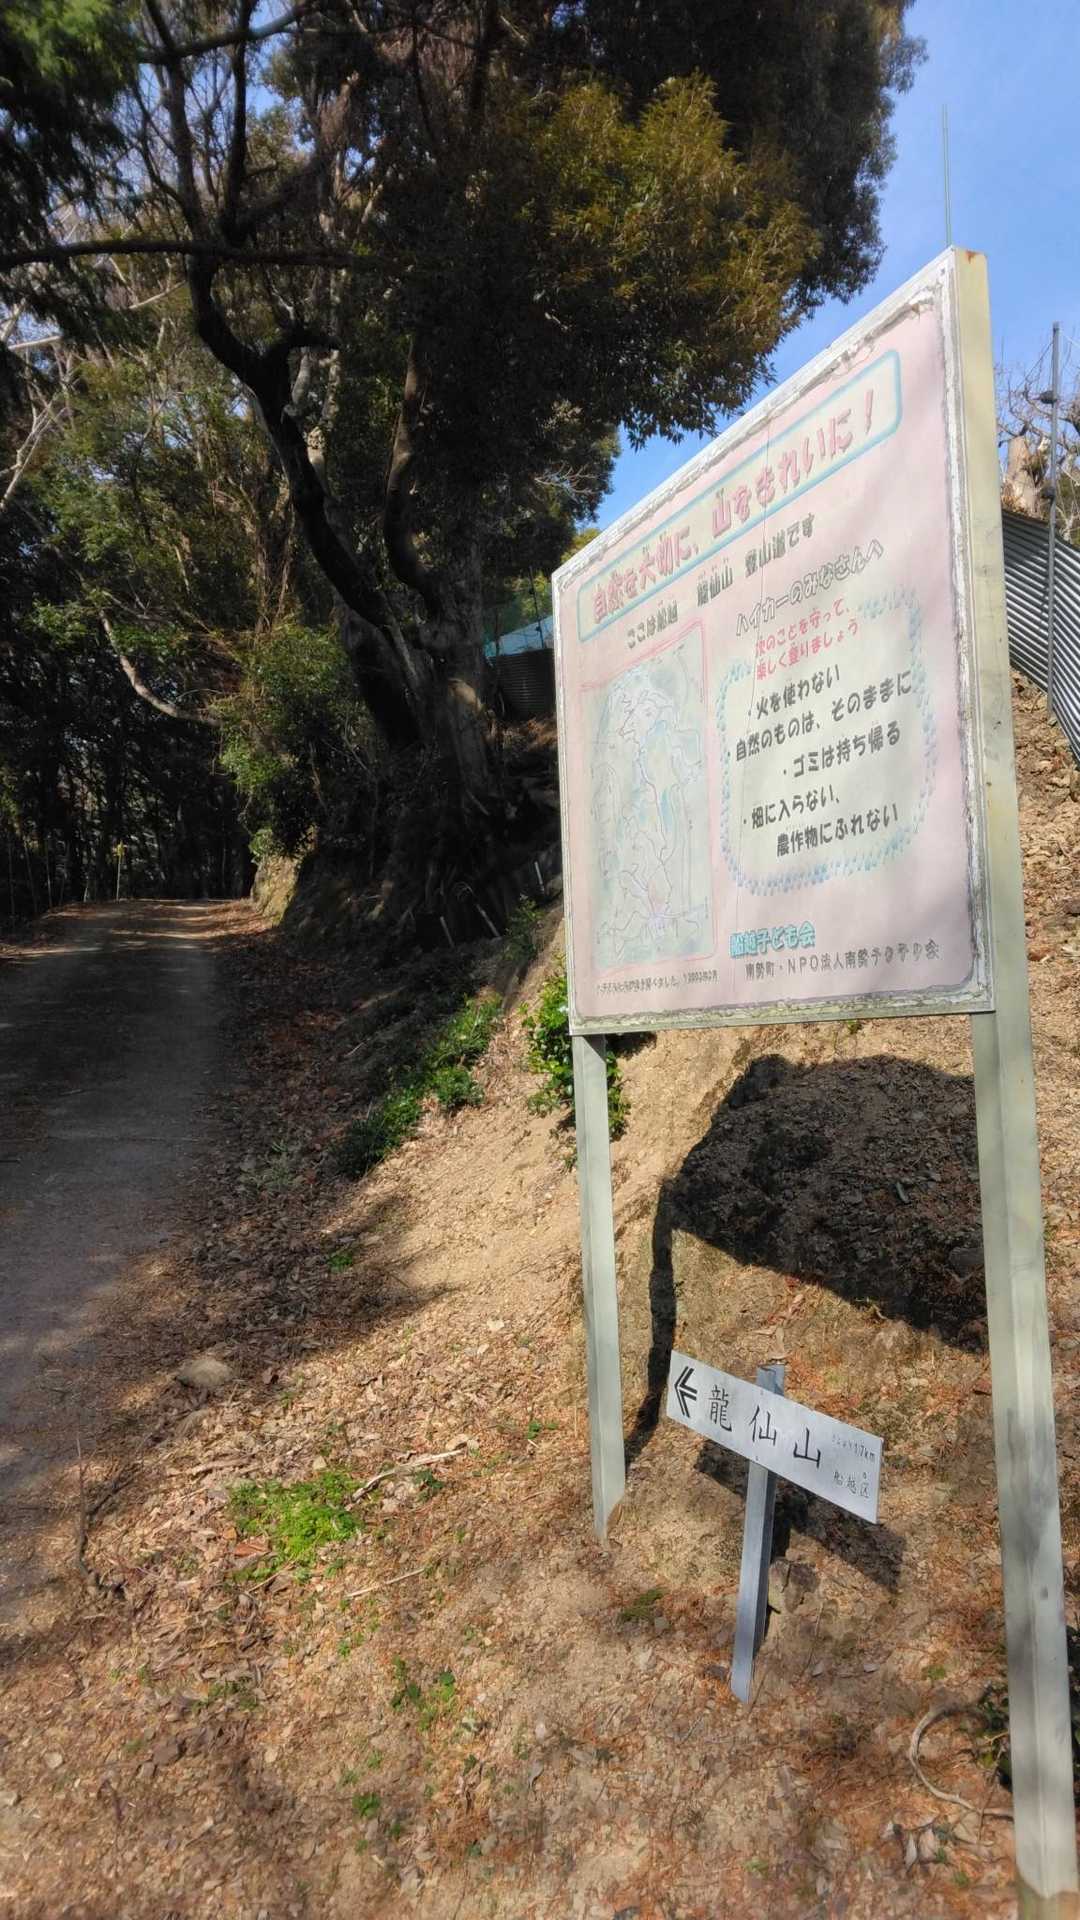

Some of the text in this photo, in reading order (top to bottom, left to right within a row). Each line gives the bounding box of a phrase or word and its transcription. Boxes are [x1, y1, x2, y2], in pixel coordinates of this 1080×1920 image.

[736, 539, 884, 636] ハイカーのみなさんへ
[756, 619, 860, 680] 楽しく登りましょう
[776, 804, 898, 857] 農作物にふれない
[708, 1384, 821, 1470] 龍仙山
